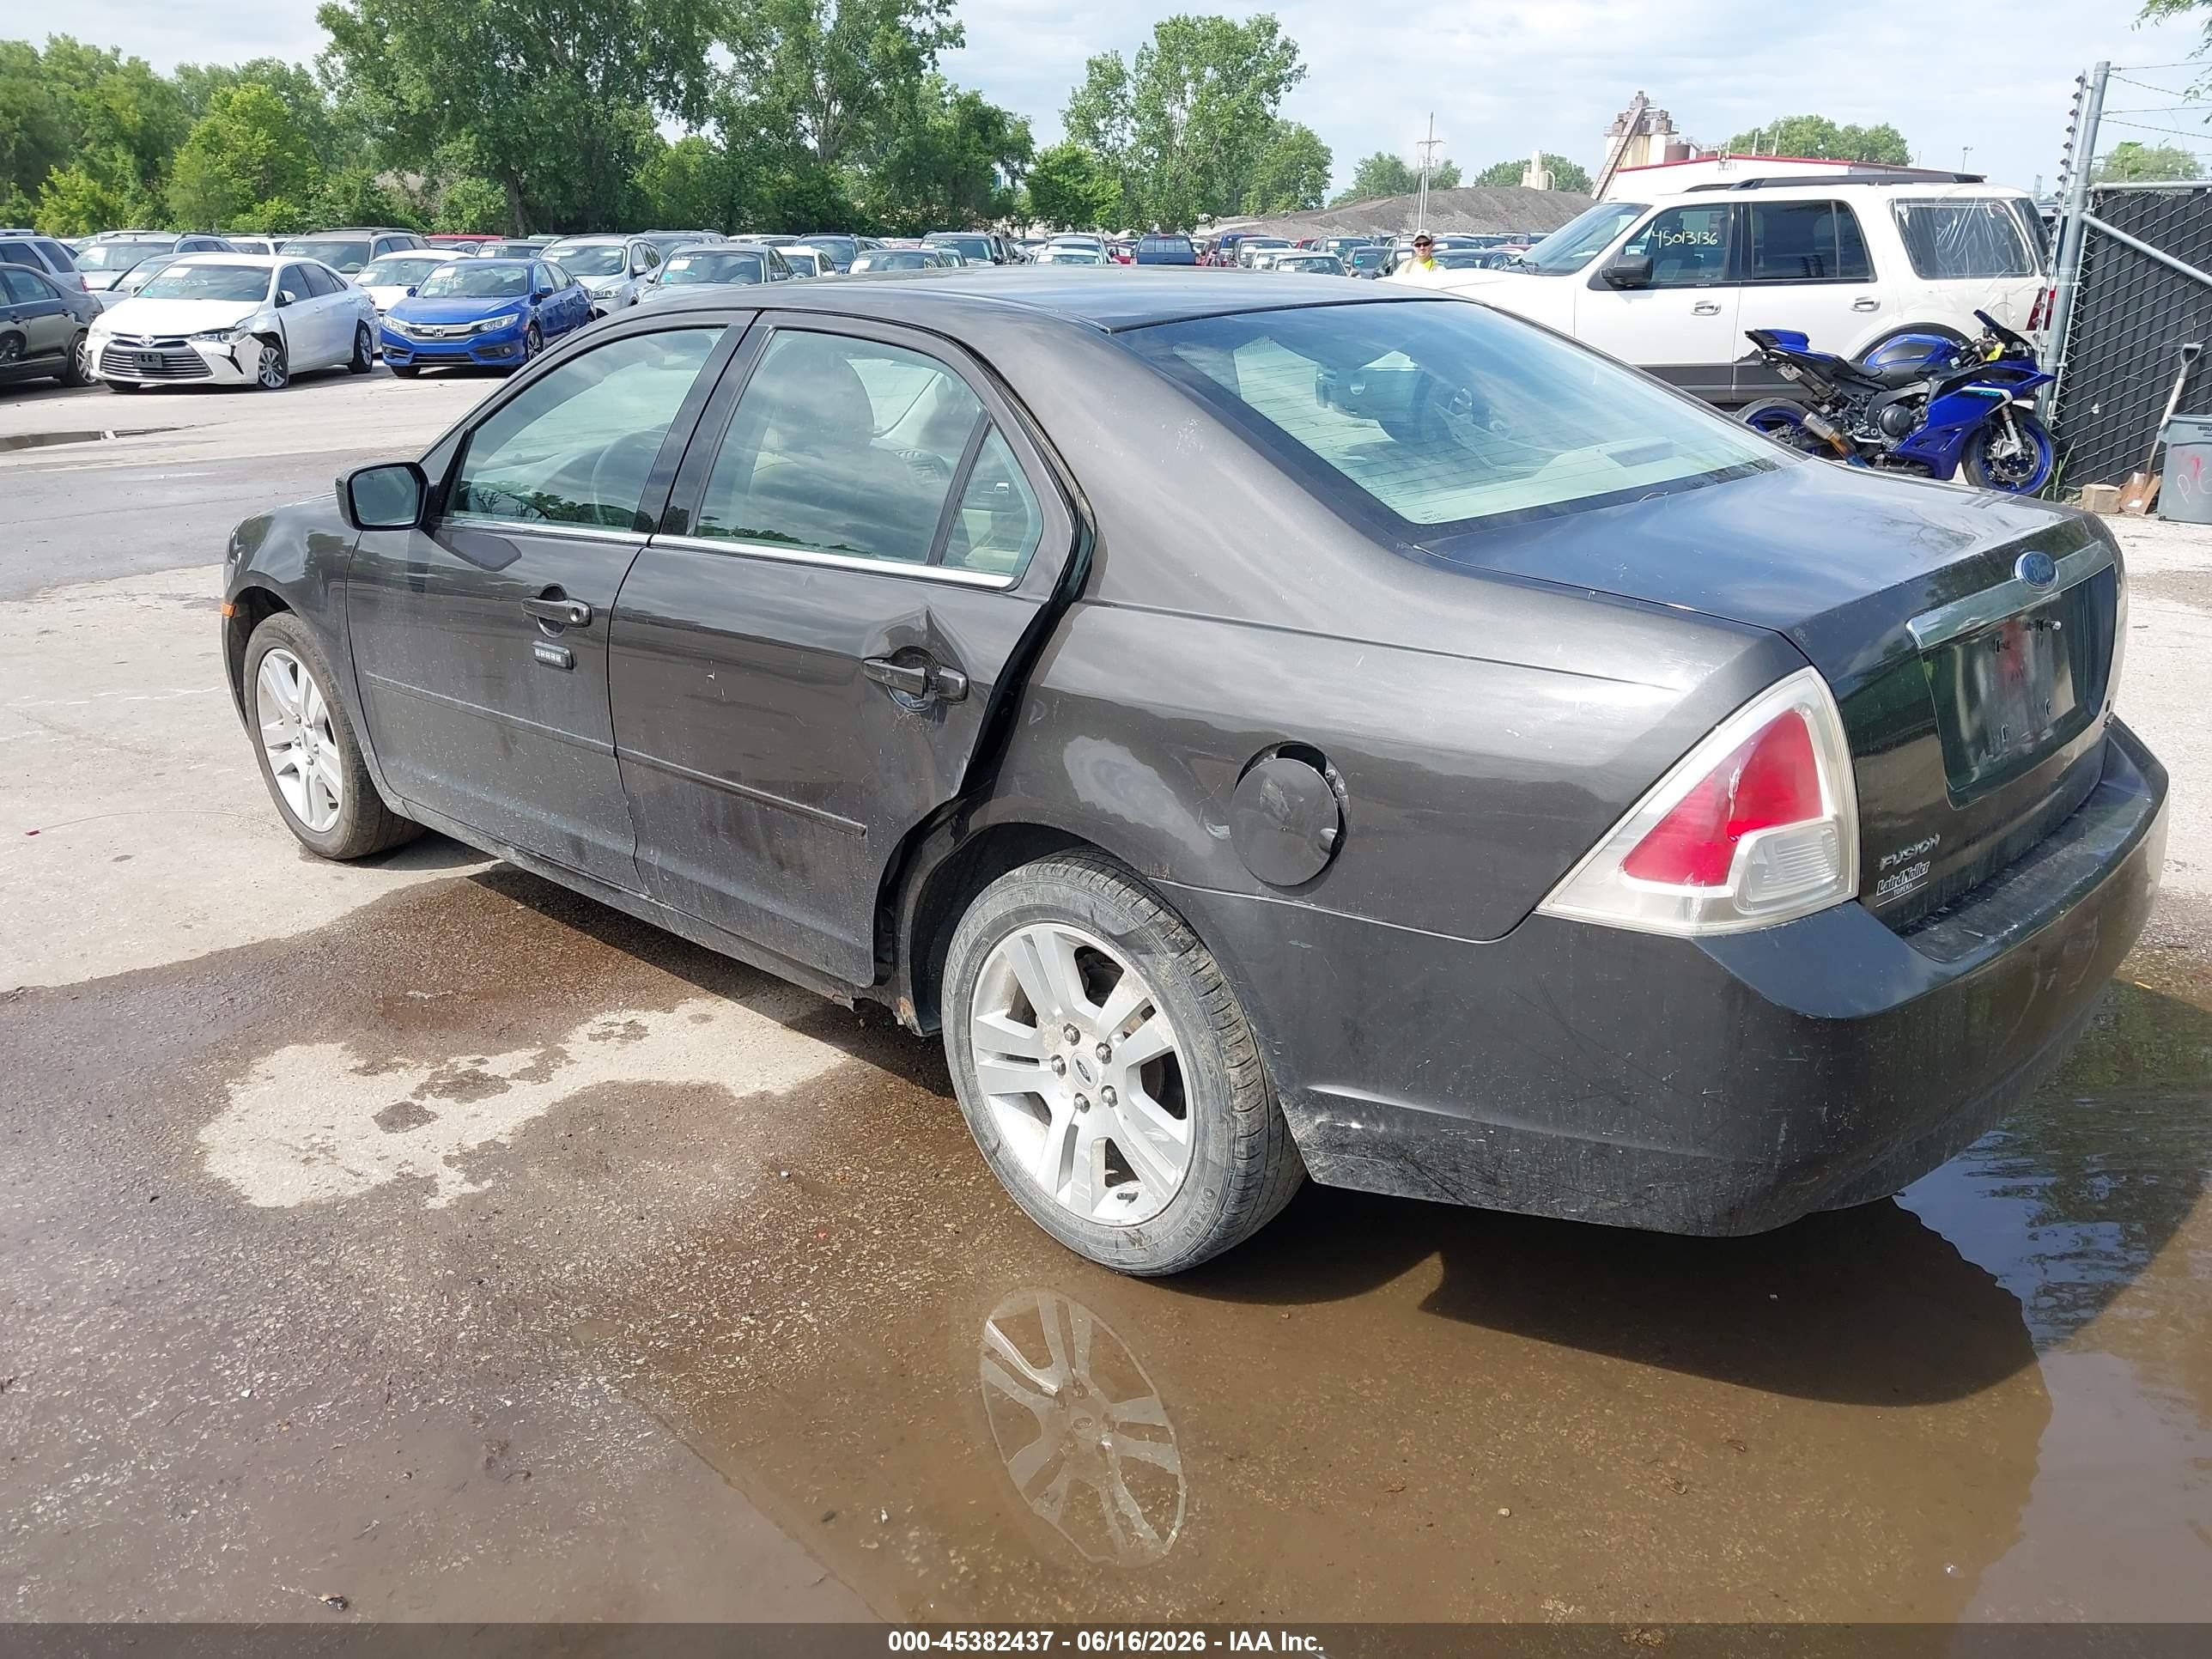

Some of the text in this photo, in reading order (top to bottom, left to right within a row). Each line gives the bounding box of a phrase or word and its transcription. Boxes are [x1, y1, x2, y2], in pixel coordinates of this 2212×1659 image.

[1651, 229, 1718, 249] 45013136
[1878, 833, 1941, 872] FUSION
[1893, 882, 1913, 896] TOPEKA
